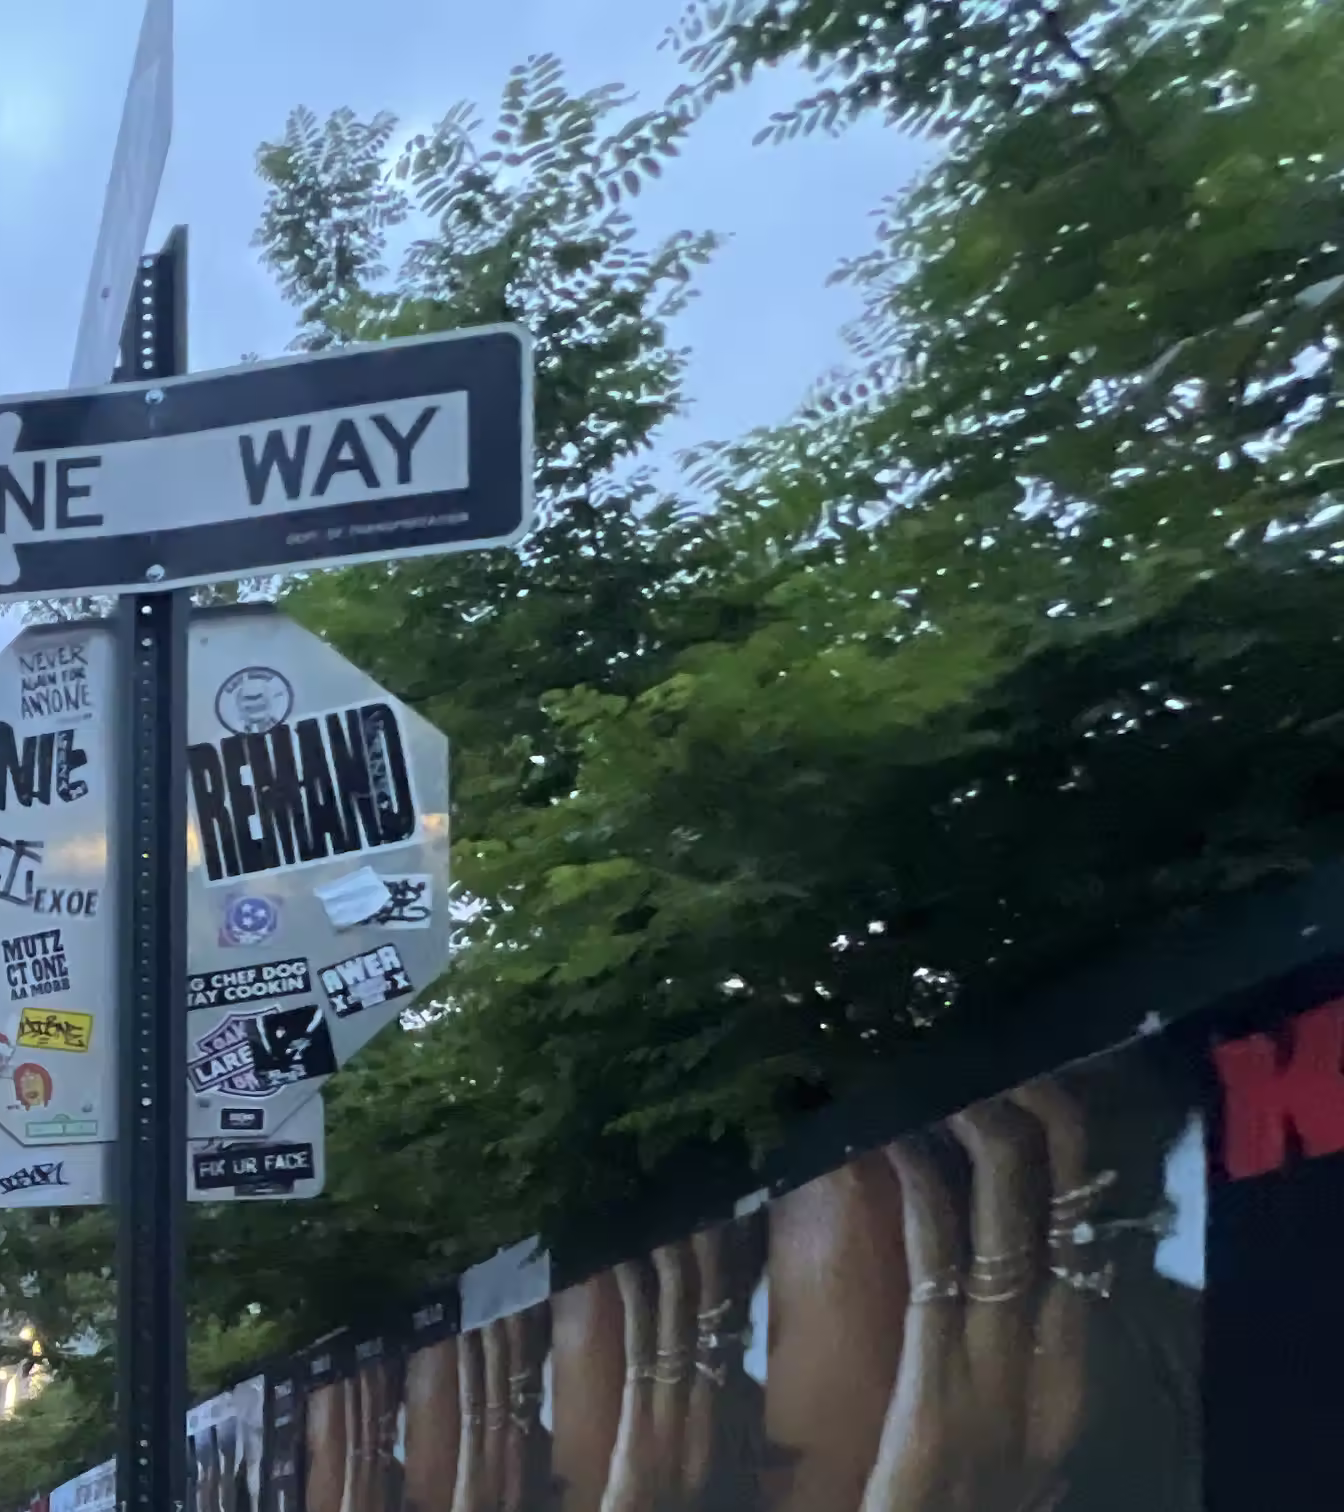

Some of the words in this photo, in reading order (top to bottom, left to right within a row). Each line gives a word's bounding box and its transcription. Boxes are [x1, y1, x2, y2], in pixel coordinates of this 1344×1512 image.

[239, 405, 442, 505] WAY
[19, 647, 89, 674] NEVER
[20, 681, 92, 720] ANYONE
[2, 928, 64, 963] MUTZ
[6, 961, 28, 987] CT
[31, 952, 69, 983] ONE
[211, 968, 256, 988] CHEF
[262, 961, 307, 980] DOG
[186, 989, 218, 1007] AY
[224, 976, 305, 1001] COOKIN
[233, 1157, 258, 1174] UR
[264, 1151, 310, 1171] FACE
